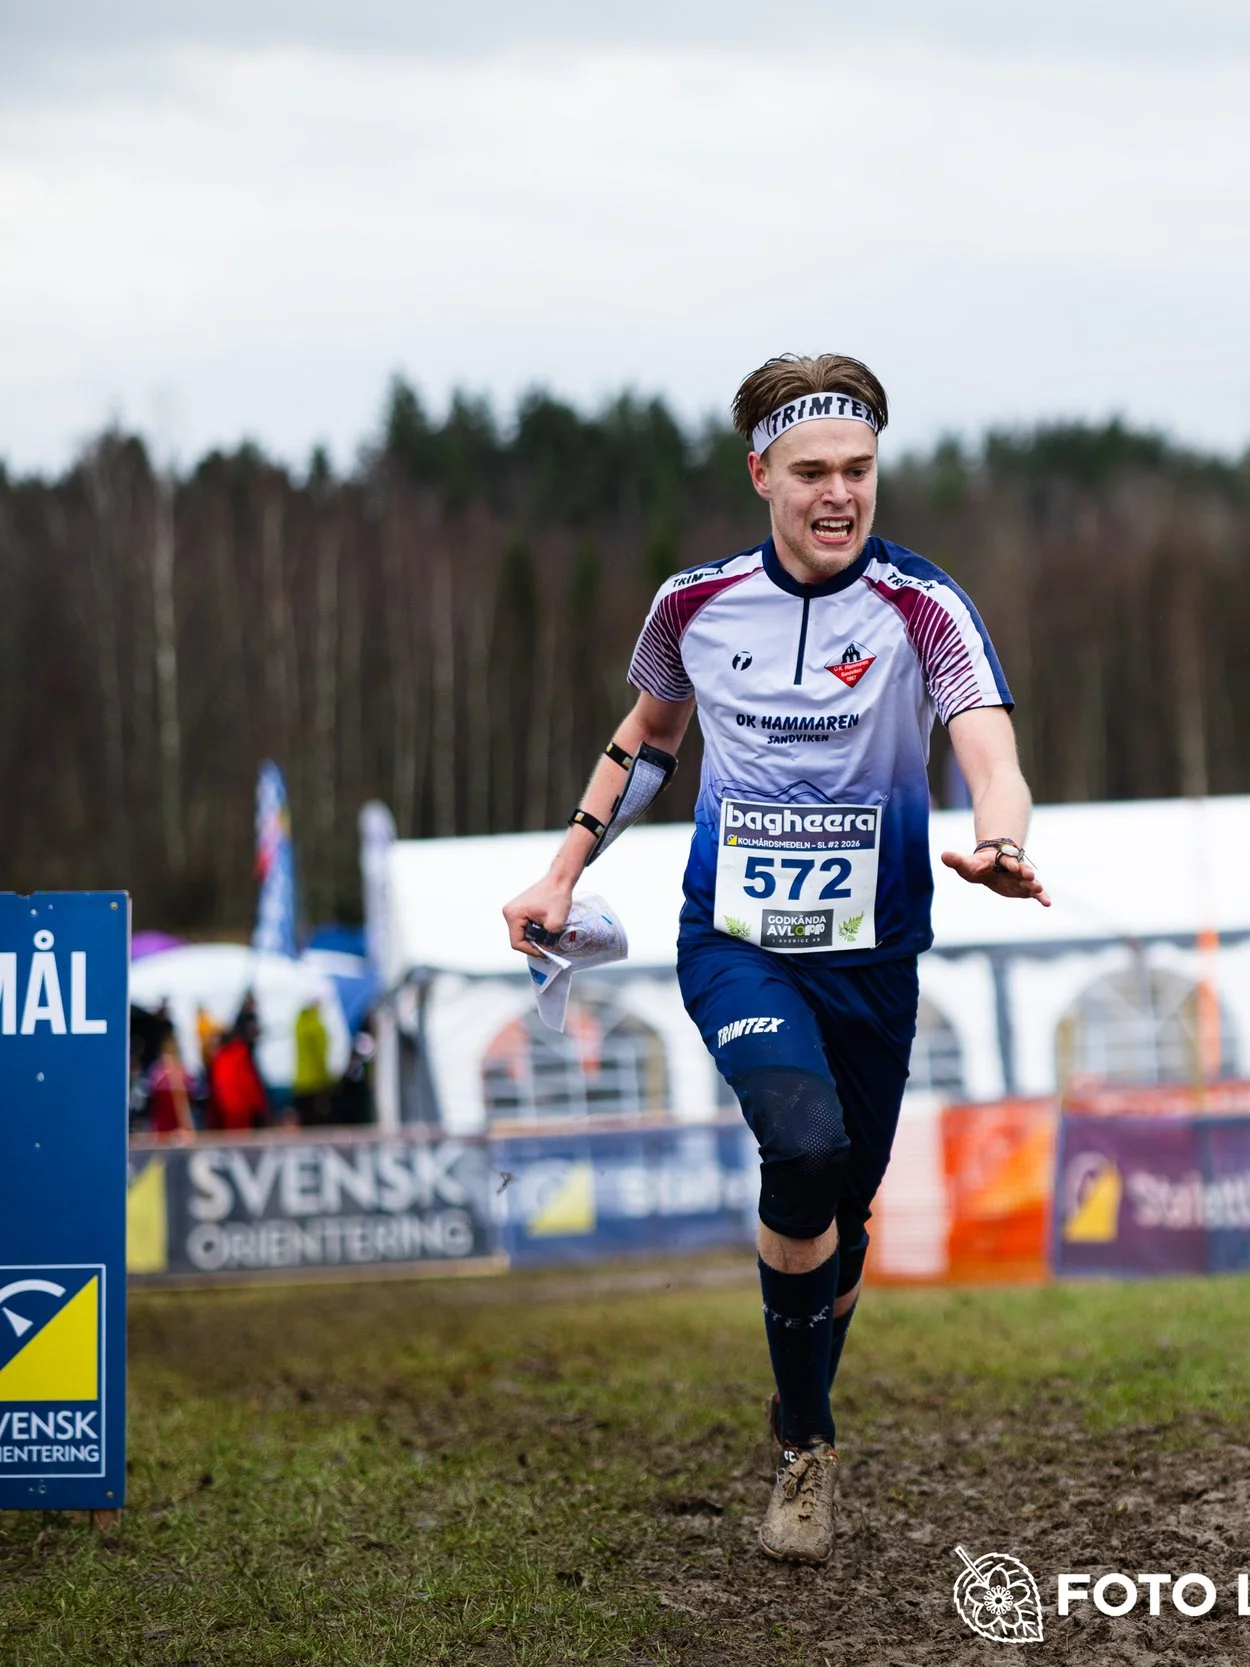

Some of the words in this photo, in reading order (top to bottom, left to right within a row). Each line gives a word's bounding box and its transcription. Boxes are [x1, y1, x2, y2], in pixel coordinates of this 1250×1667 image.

[771, 396, 874, 435] TRIMTEX
[736, 713, 756, 729] OK
[761, 714, 859, 731] HAMMAREN
[767, 734, 829, 744] SANDVIKEN
[726, 804, 875, 836] bagheera
[738, 836, 810, 849] KOLMÅRDSMEDELN
[828, 841, 839, 849] #2
[841, 840, 860, 848] 2026
[743, 856, 852, 900] 572
[768, 914, 827, 925] GODKÄNDA
[718, 1017, 785, 1049] TRIMTEX
[188, 1140, 465, 1222] SVENSK
[187, 1208, 474, 1271] ORIENTERING
